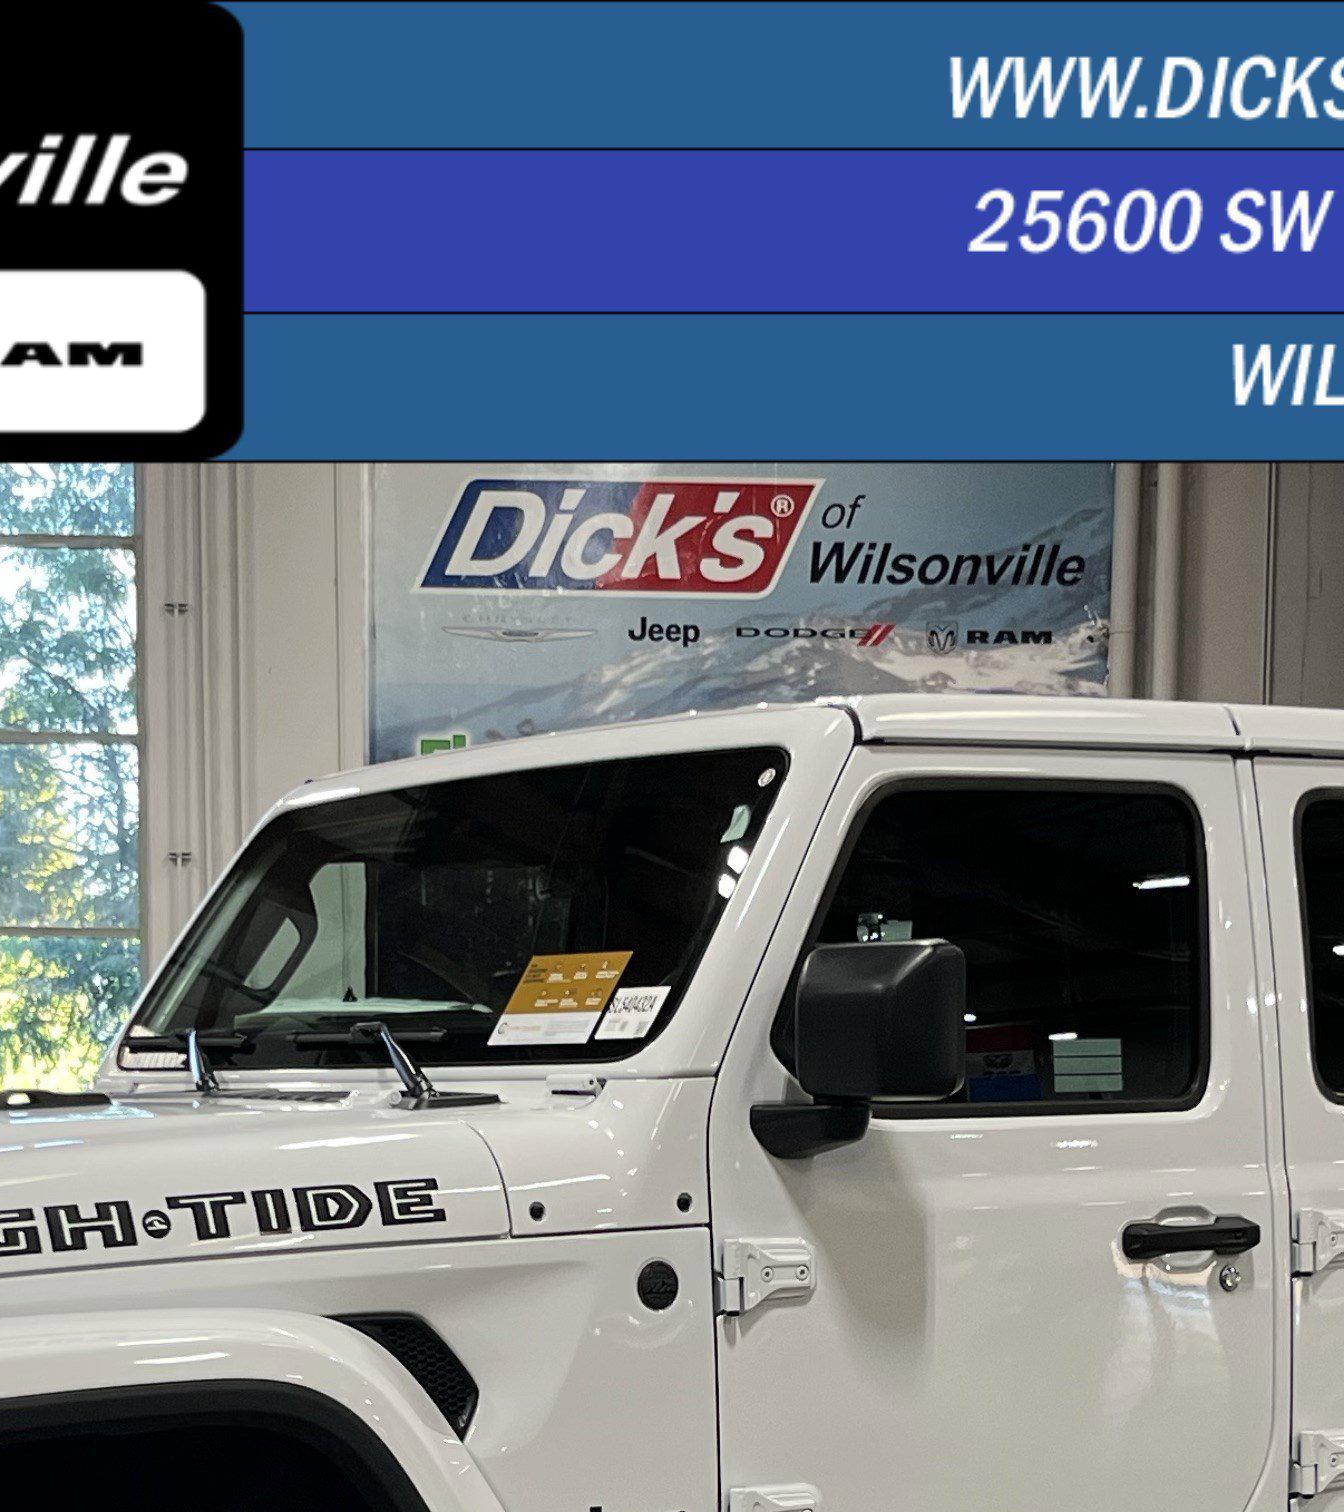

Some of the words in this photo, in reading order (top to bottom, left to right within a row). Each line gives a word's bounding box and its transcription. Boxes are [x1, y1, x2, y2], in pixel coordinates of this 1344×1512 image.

[820, 495, 867, 530] of
[808, 540, 1086, 588] Wilsonville
[627, 616, 701, 648] Jeep
[735, 626, 870, 639] DODGE
[966, 628, 1053, 646] RAM
[165, 1176, 449, 1241] TIDE
